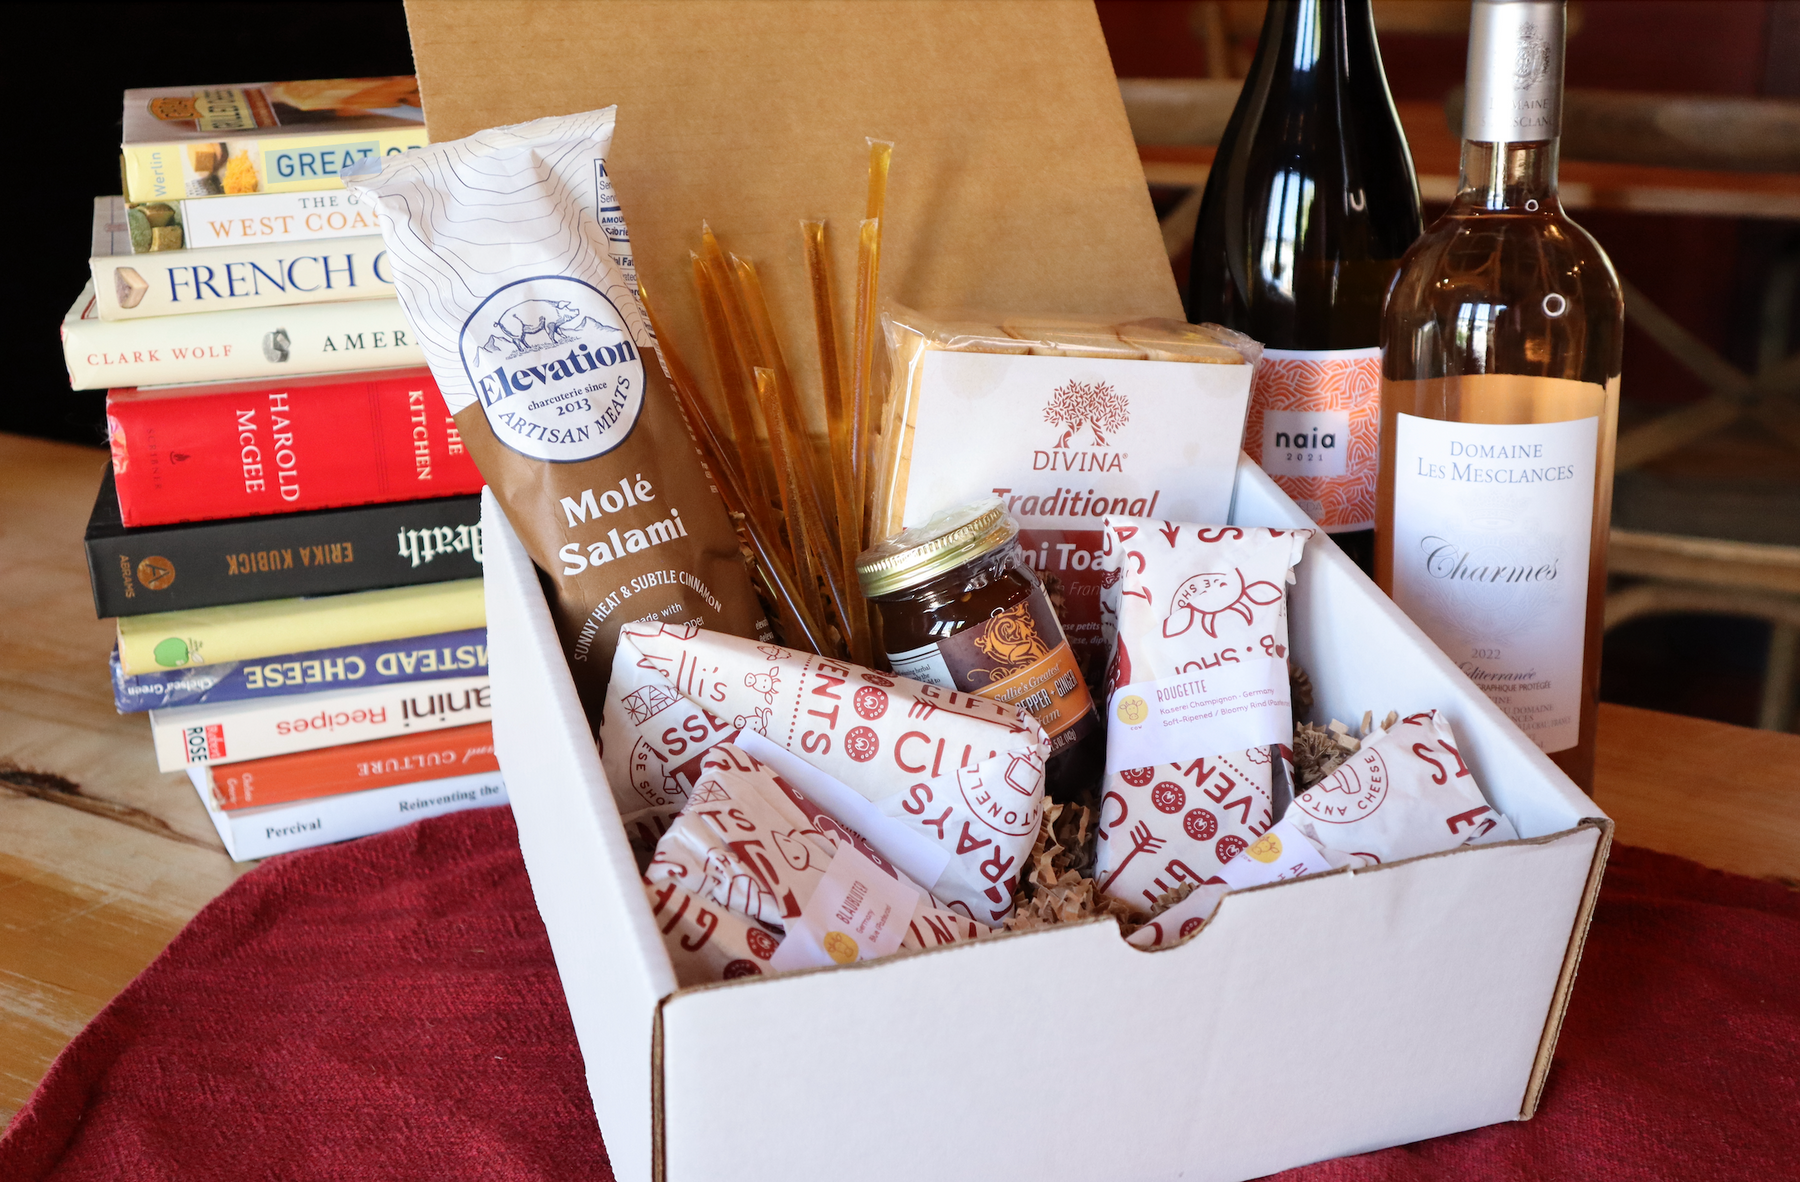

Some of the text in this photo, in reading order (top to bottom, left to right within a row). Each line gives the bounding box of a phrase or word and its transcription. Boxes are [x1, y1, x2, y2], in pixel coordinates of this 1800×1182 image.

[149, 152, 167, 198] Werlin
[298, 196, 338, 208] THE
[209, 215, 294, 239] WEST
[165, 253, 357, 303] FRENCH
[322, 330, 408, 352] AMER
[86, 344, 233, 367] CLARK WOLF
[478, 340, 637, 409] Elevation
[498, 375, 631, 444] ARTISAN MEATS
[527, 380, 608, 411] charcuterie since
[556, 398, 592, 416] 2013
[270, 392, 300, 502] HAROLD
[408, 390, 432, 480] KITCHEN
[1275, 427, 1336, 449] naia
[1286, 453, 1324, 461] 2021
[1450, 441, 1543, 459] DOMAINE
[1451, 462, 1575, 484] MESCLANCES
[559, 473, 656, 528] Molé
[992, 488, 1160, 518] Traditional
[558, 507, 689, 576] Salami
[226, 541, 354, 575] ERIKA KUBICK
[1056, 543, 1104, 571] Toa
[1420, 536, 1559, 583] Charmes
[119, 555, 135, 598] ABRAMS
[574, 569, 722, 662] SUNNY HEAT & SUBTLE CINNAMON
[661, 602, 683, 617] with
[1076, 621, 1100, 632] petits
[1471, 648, 1501, 660] 2022
[244, 658, 366, 689] CHEESE
[992, 663, 1060, 702] Sallie's Greatest
[1054, 669, 1078, 698] GINGER
[1156, 679, 1208, 703] ROUGETTE
[1159, 703, 1189, 715] Kaserei
[1189, 694, 1238, 709] Champignon
[1242, 687, 1275, 698] Germany
[276, 706, 387, 736] Recipes
[1162, 711, 1213, 727] Soft-Ripened
[1220, 704, 1249, 716] Bloomy
[1250, 699, 1267, 709] Rind
[1513, 704, 1554, 716] DOMAINE
[186, 726, 207, 763] ROSE
[205, 725, 226, 758] Robert
[357, 749, 457, 777] CULTURE
[1357, 755, 1382, 811] CHEESE
[399, 784, 499, 812] Reinventing the
[266, 819, 322, 839] Percival
[856, 909, 874, 935] Germany
